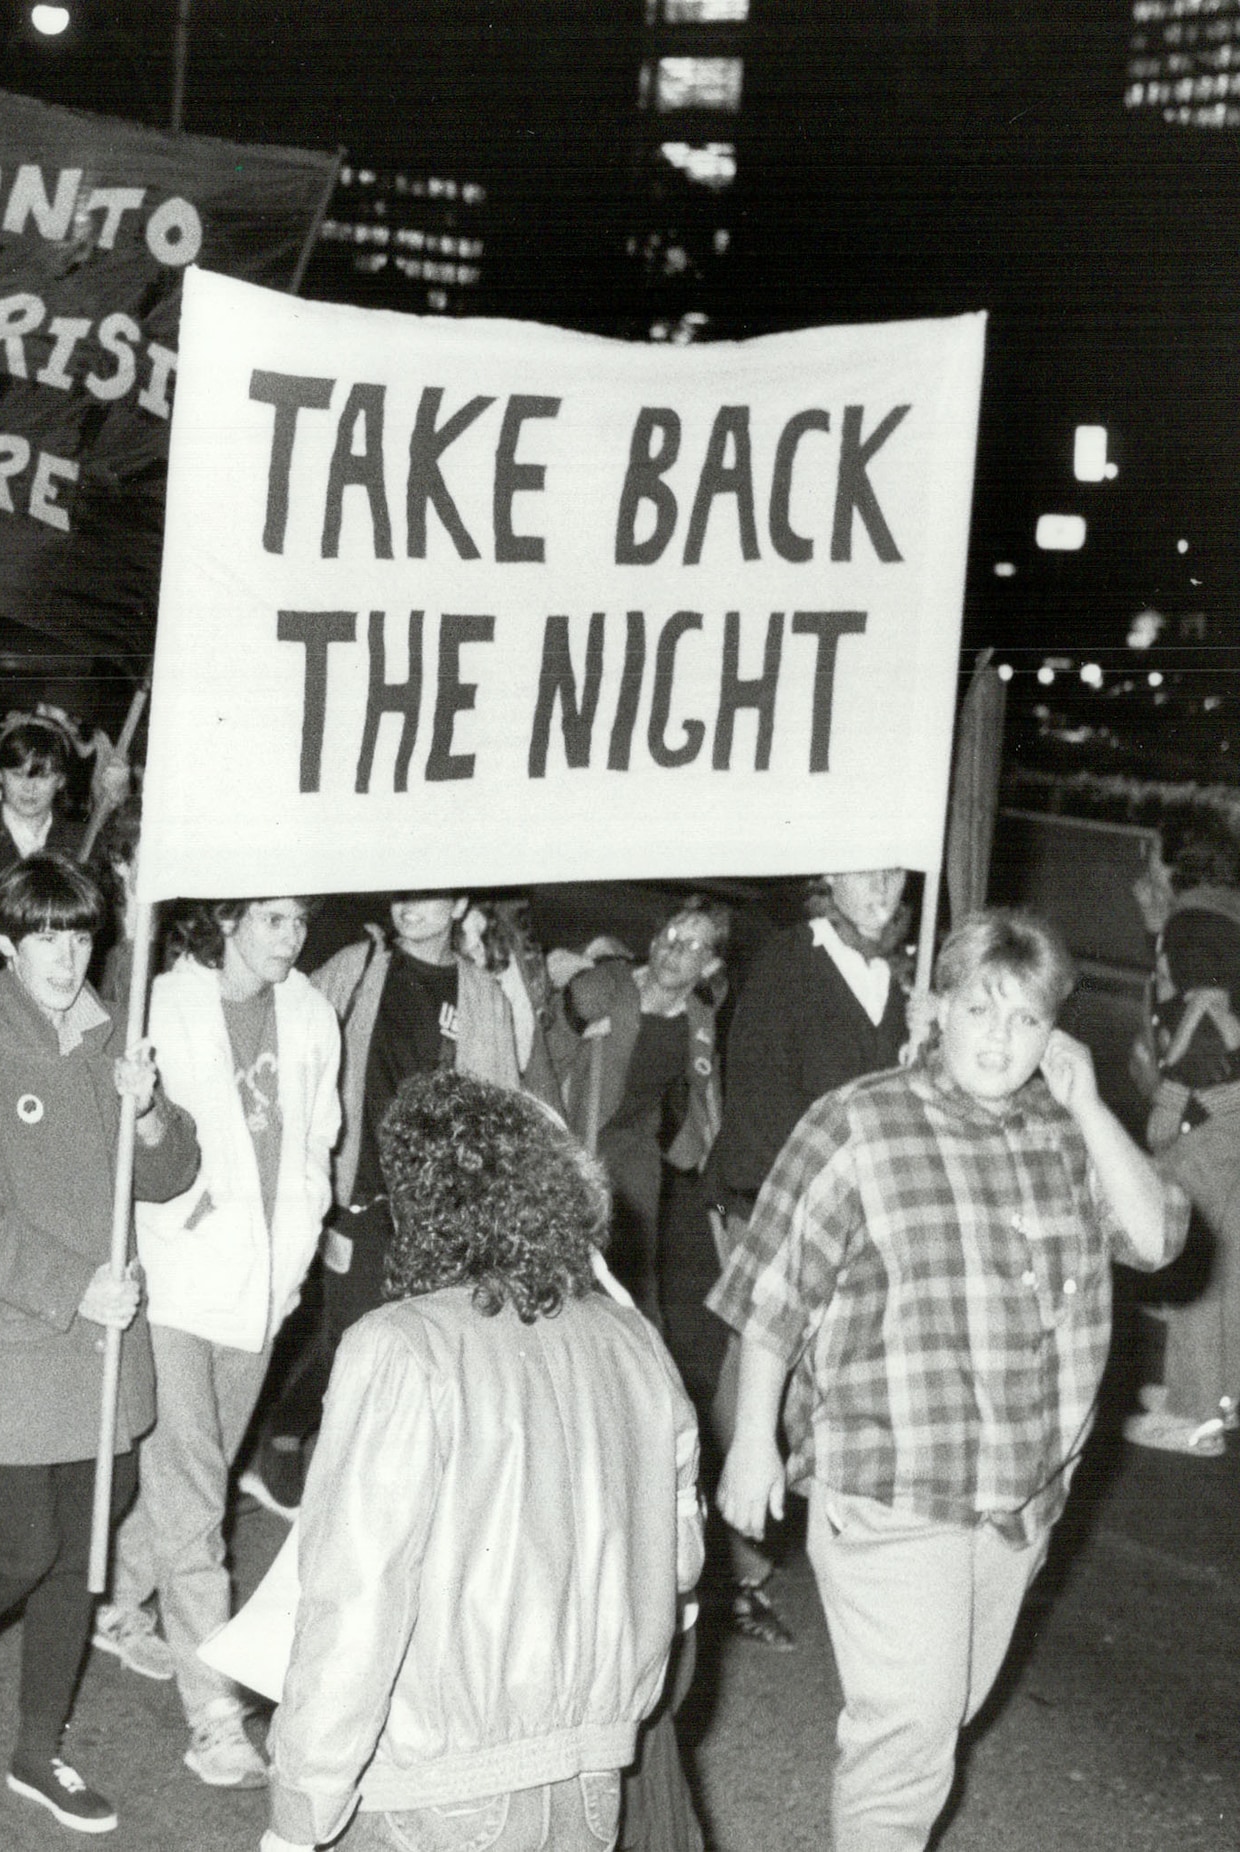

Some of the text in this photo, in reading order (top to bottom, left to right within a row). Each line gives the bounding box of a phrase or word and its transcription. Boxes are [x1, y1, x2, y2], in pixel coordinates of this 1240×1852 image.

[249, 369, 912, 566] TAKE BACK
[276, 610, 868, 794] THE NIGHT
